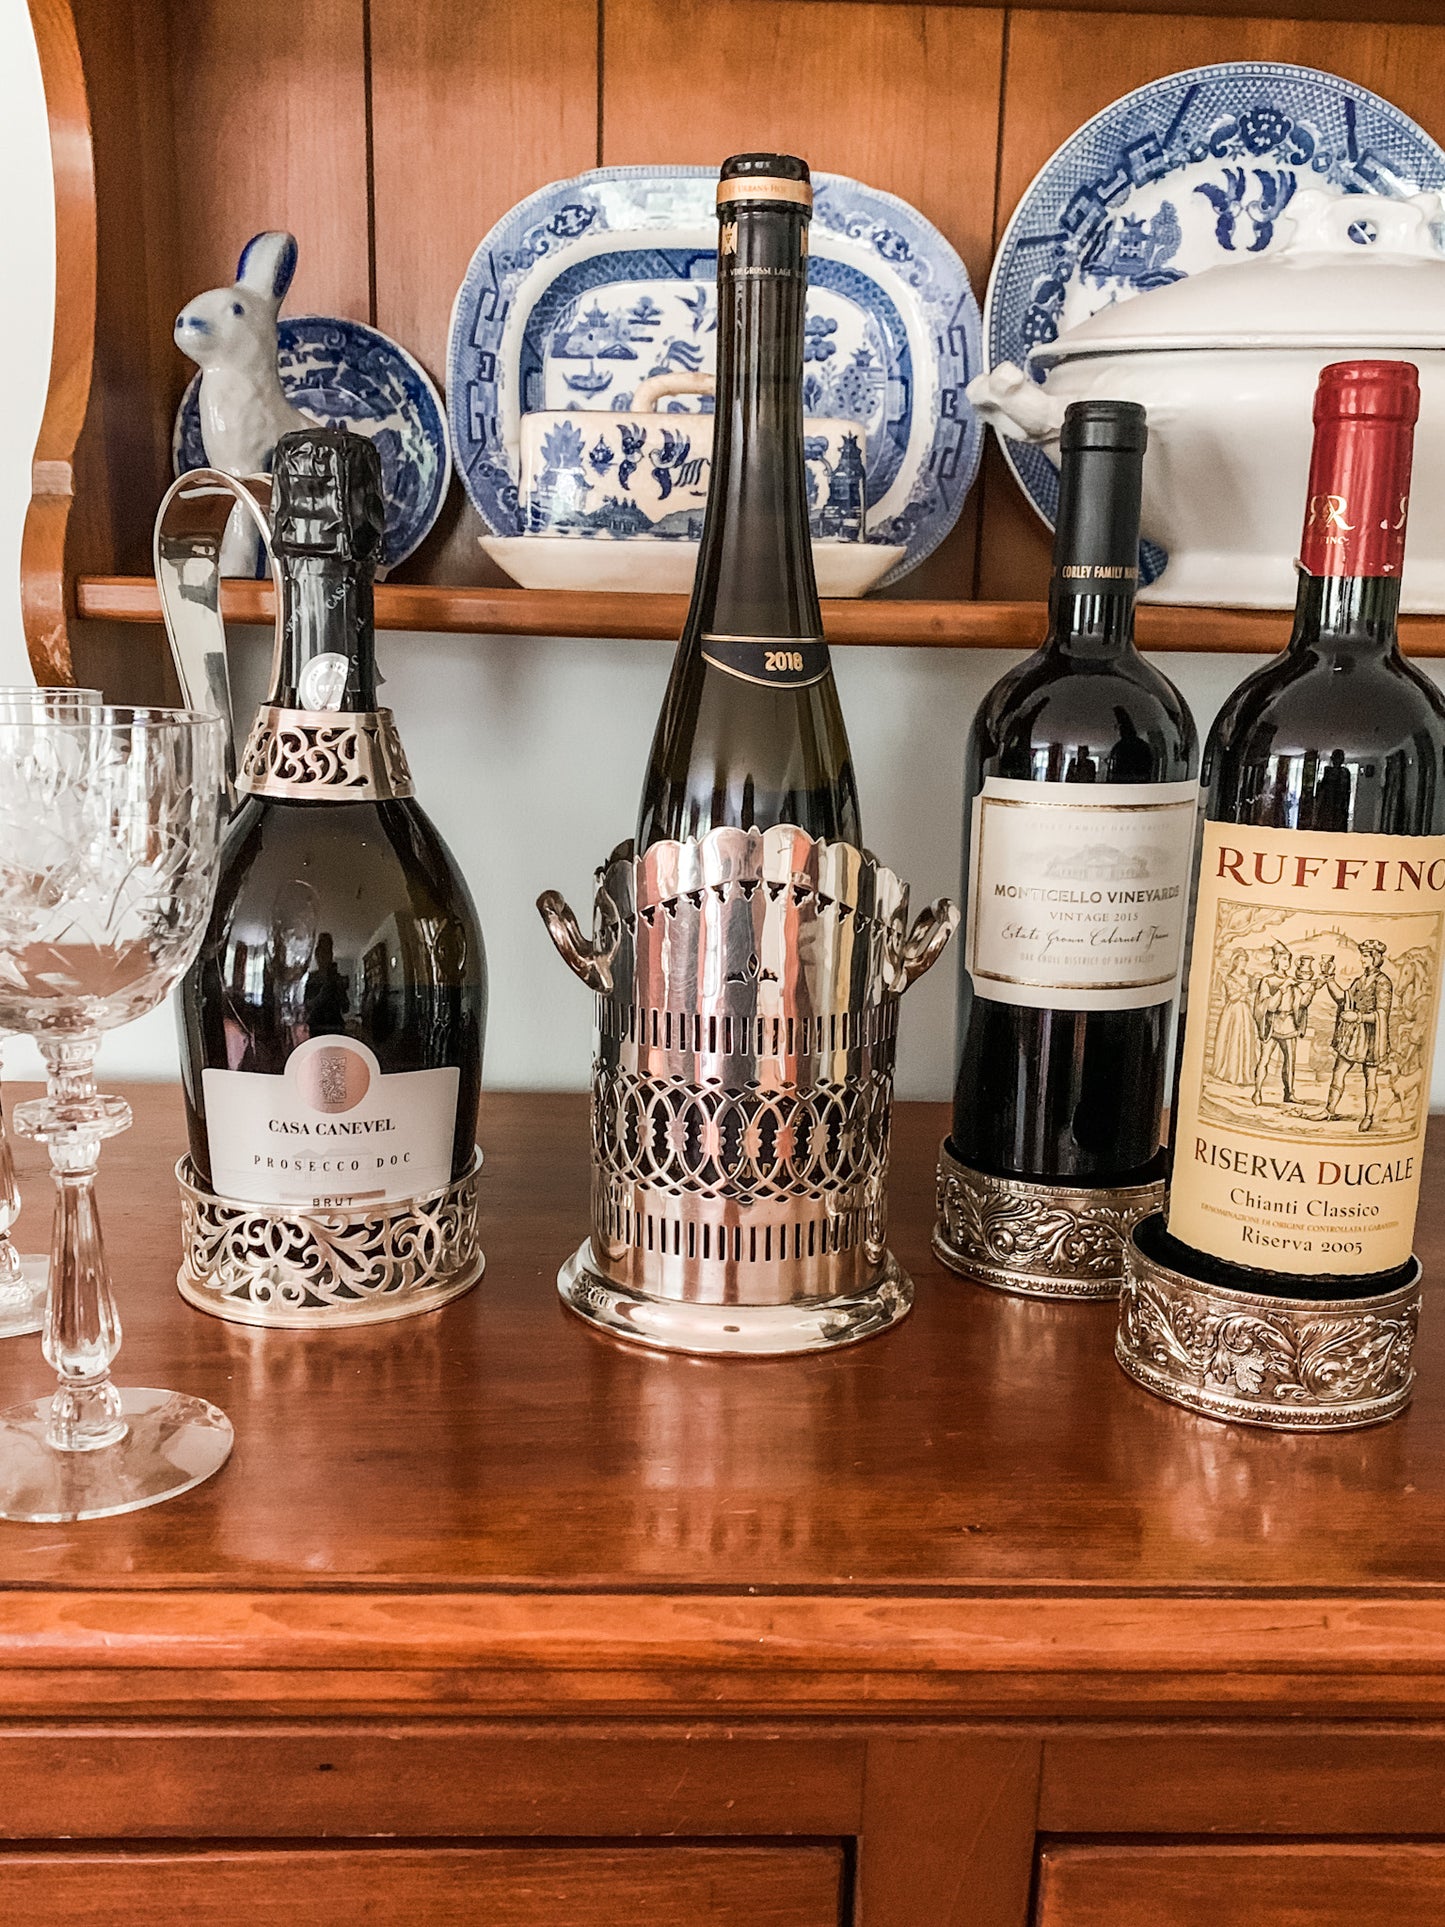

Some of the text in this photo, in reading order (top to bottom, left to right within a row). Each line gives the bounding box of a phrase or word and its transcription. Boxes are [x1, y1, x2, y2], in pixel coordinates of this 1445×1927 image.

[1062, 565, 1092, 579] CORLEY
[1093, 565, 1123, 579] FAMILY
[764, 651, 804, 672] 2018
[994, 884, 1180, 904] MONTICELLO VINEYARDS
[1050, 911, 1139, 922] VINTAGE 2015
[1001, 922, 1039, 940] Estate
[1090, 926, 1142, 946] Cabernet
[268, 1118, 396, 1136] CASA CANEVEL
[254, 1151, 411, 1172] PROSECCO DOC
[1194, 1137, 1414, 1186] RISERVA DUCALE
[312, 1197, 354, 1208] BRUT
[1230, 1187, 1380, 1218] Chianti Classico
[1261, 1218, 1271, 1226] DI
[1242, 1225, 1363, 1255] Riserva 2005
